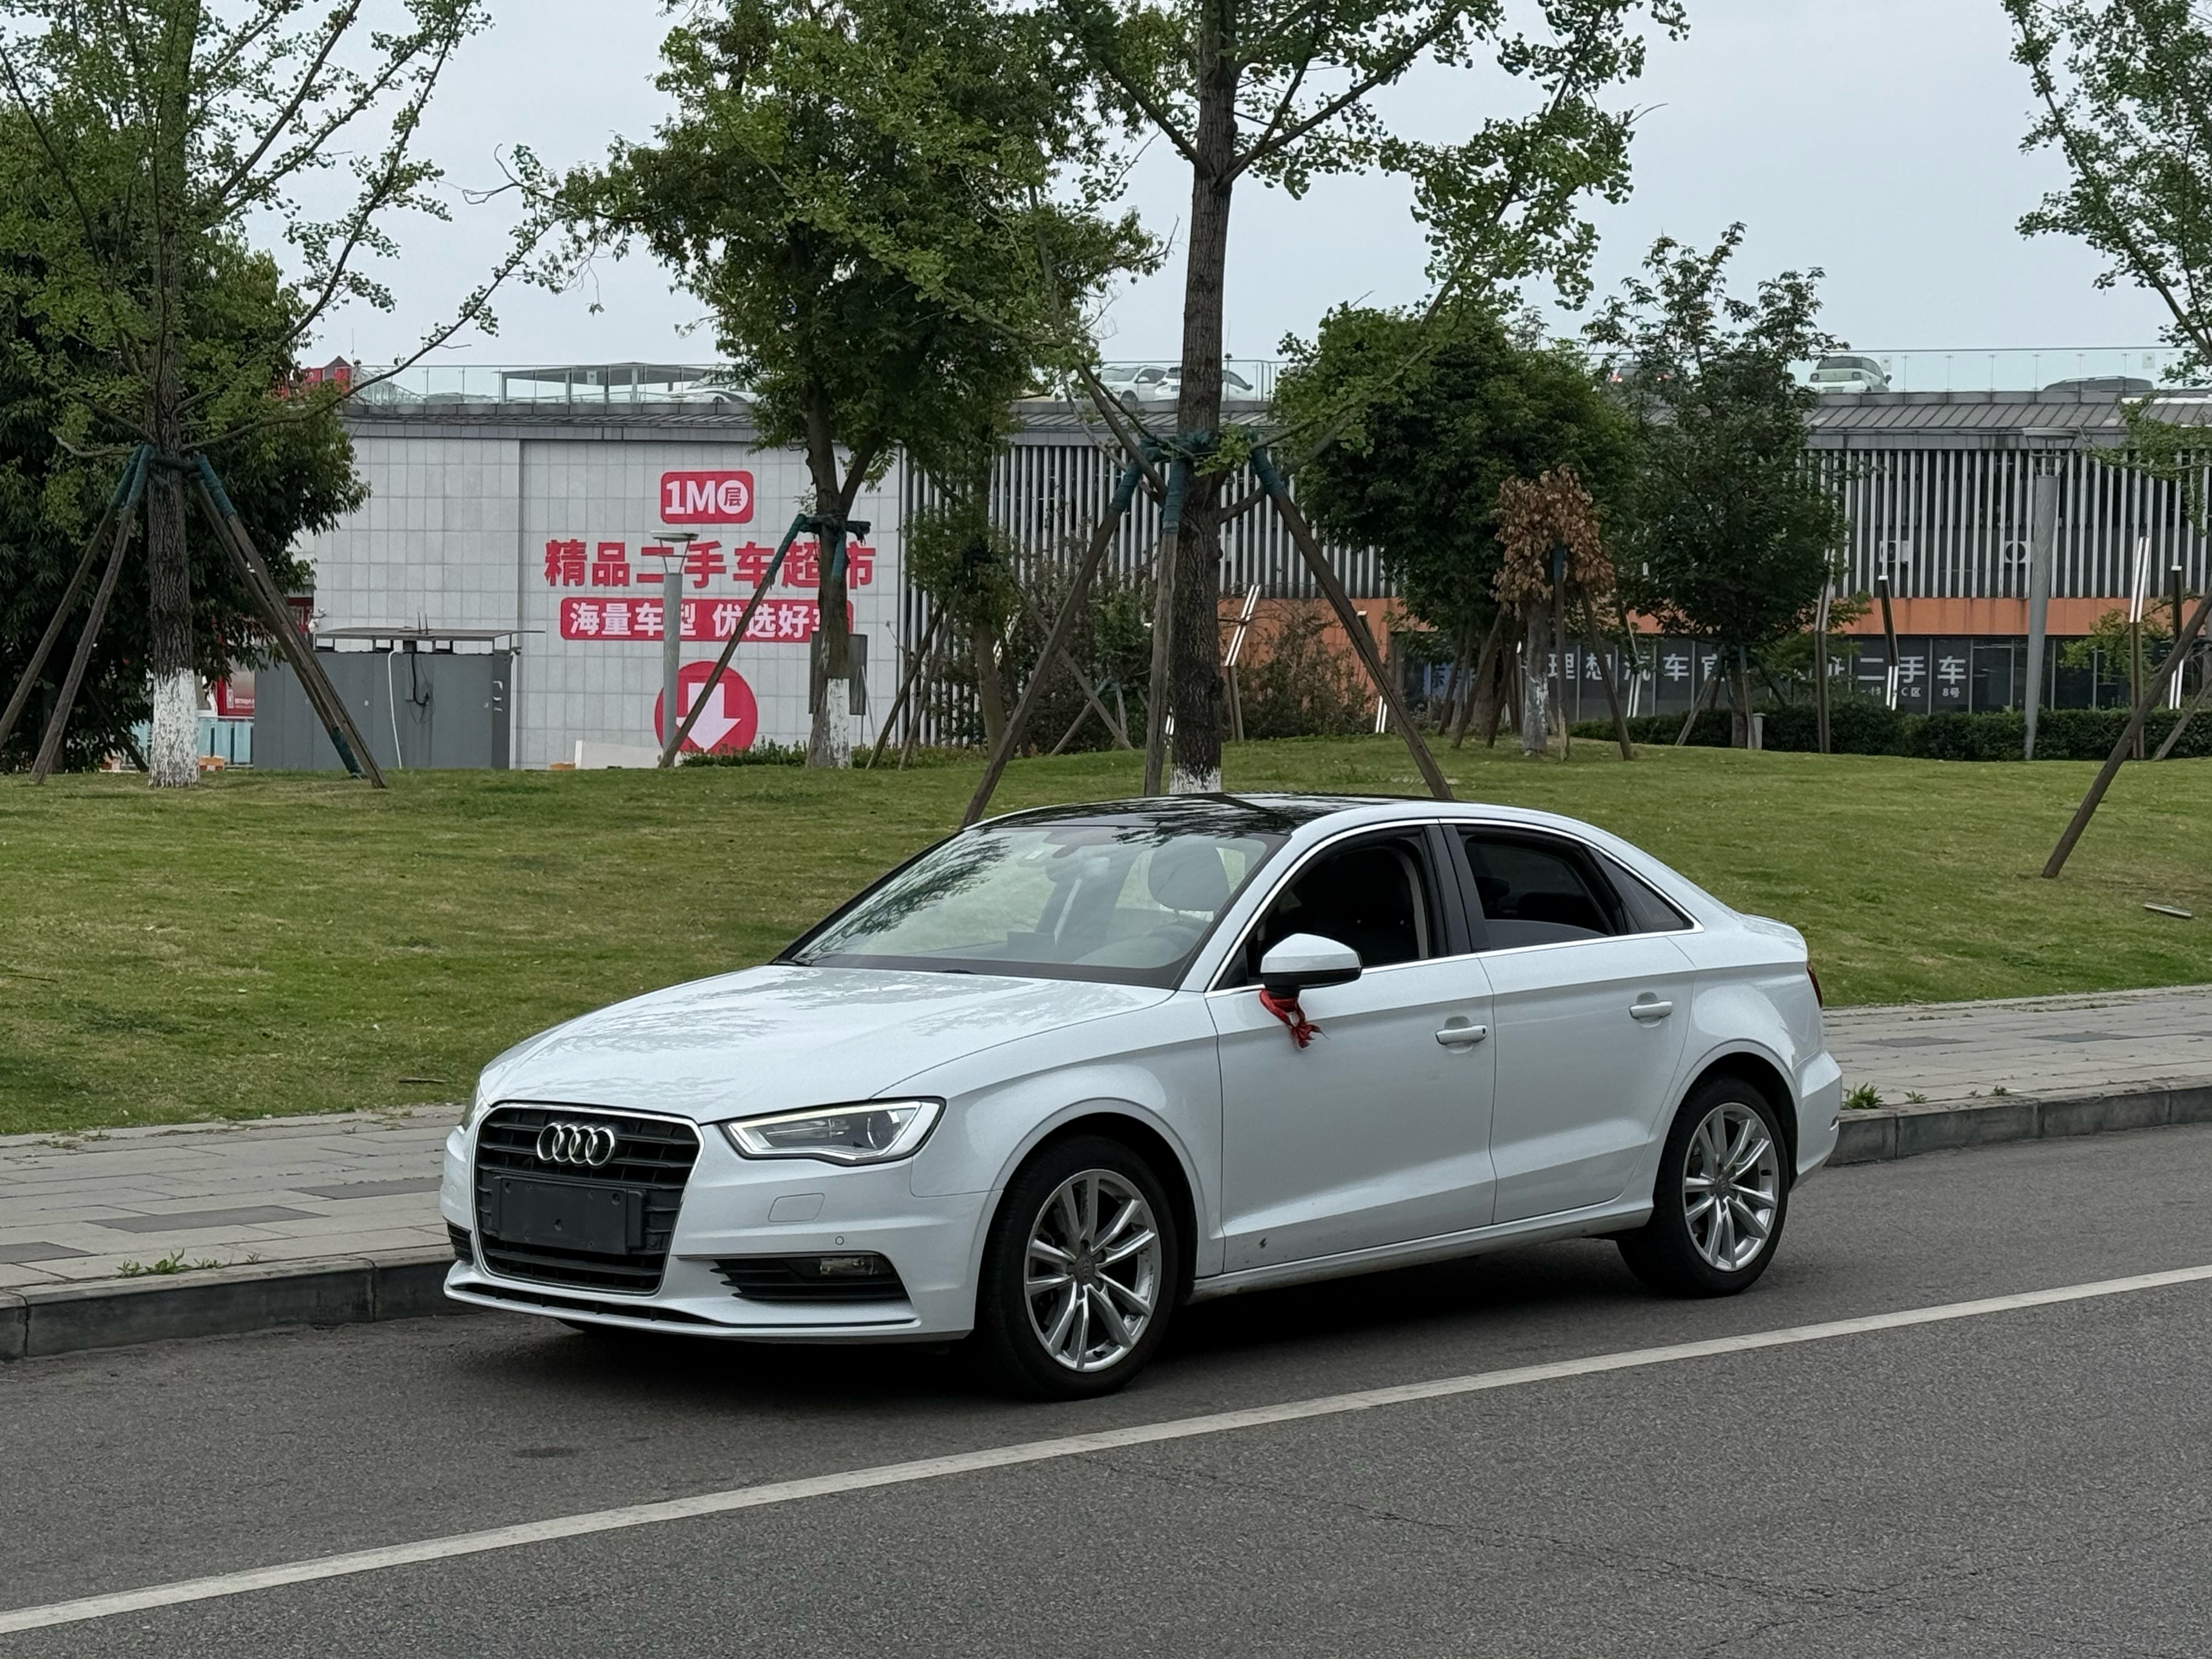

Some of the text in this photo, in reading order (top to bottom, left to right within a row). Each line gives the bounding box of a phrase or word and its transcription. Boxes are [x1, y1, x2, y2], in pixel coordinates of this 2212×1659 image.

[544, 539, 876, 590] 精品二手车超市
[712, 603, 820, 638] 优选好
